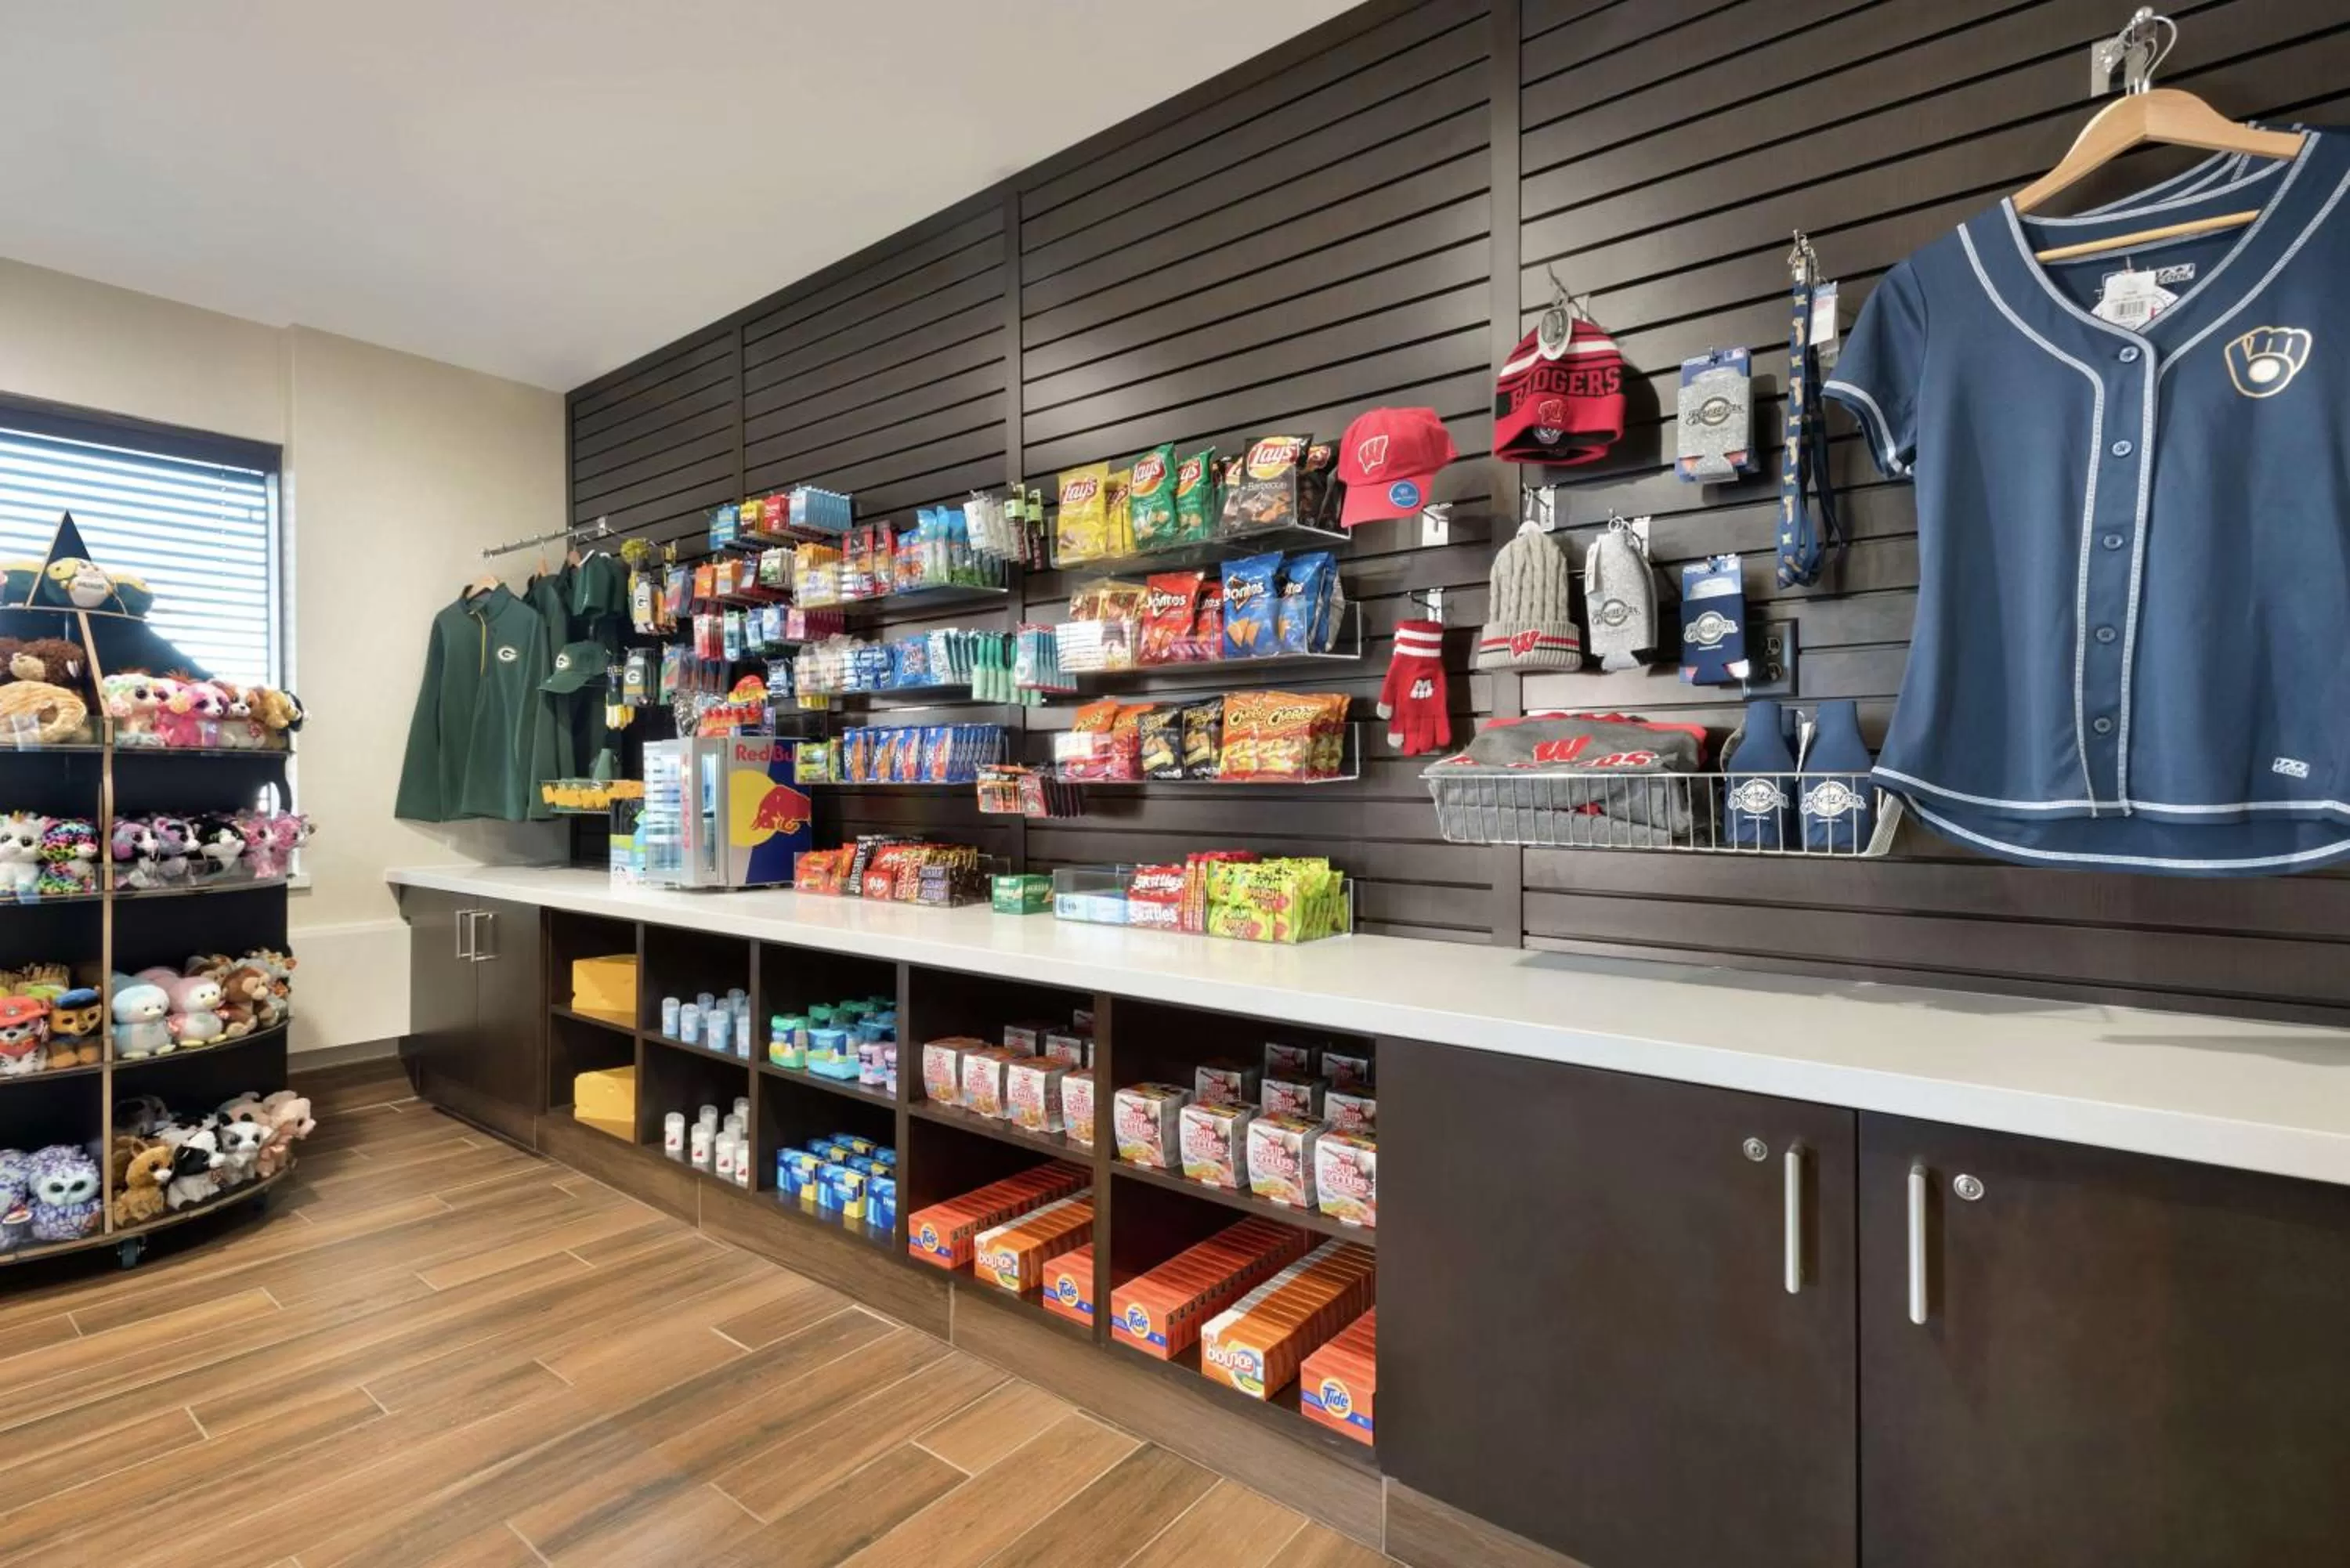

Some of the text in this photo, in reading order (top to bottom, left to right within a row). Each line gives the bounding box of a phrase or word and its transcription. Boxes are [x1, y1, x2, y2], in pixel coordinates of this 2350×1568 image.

[497, 646, 518, 662] G
[1509, 629, 1542, 659] W
[735, 744, 795, 763] Red Bu
[1533, 734, 1593, 763] W
[1131, 873, 1185, 893] Skittles
[1129, 903, 1178, 923] Skittles
[1058, 1281, 1077, 1297] Tide
[1128, 1310, 1148, 1328] Tide
[1324, 1386, 1349, 1407] Tide
